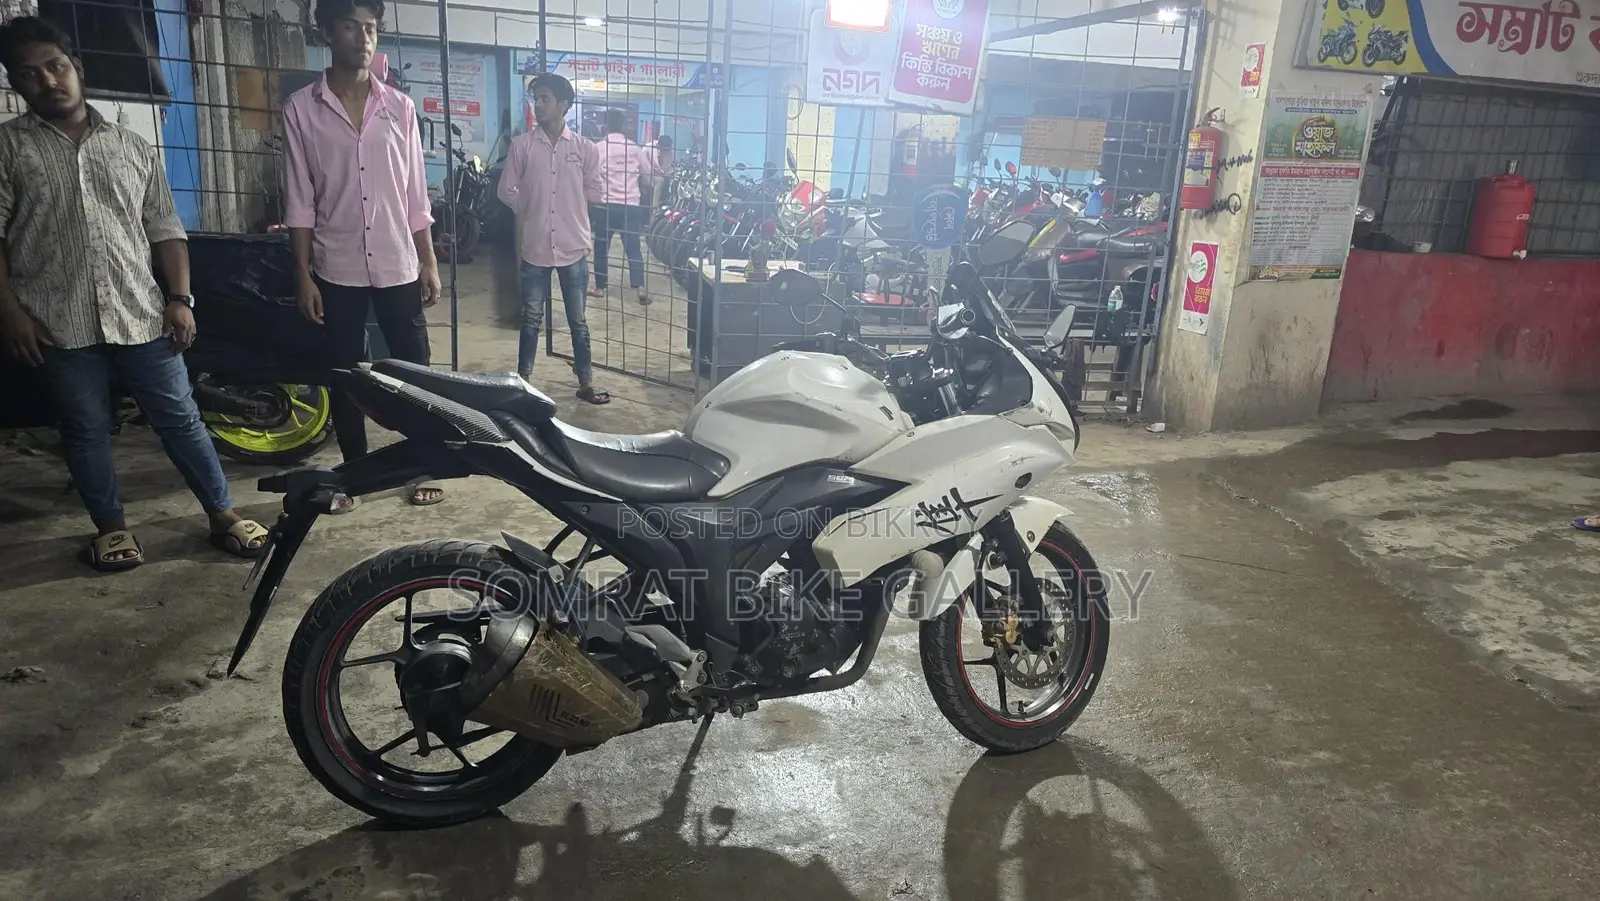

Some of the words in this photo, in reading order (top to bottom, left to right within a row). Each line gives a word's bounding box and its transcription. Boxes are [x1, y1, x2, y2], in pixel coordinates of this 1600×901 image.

[916, 23, 951, 43] সঞ্চয়
[953, 31, 963, 44] ও
[1456, 0, 1580, 55] সম্রাট
[922, 40, 960, 59] ঋণের
[901, 52, 932, 73] কিস্তি
[935, 57, 974, 80] বিকাশ
[822, 68, 881, 94] নগদ
[916, 72, 951, 91] করুন
